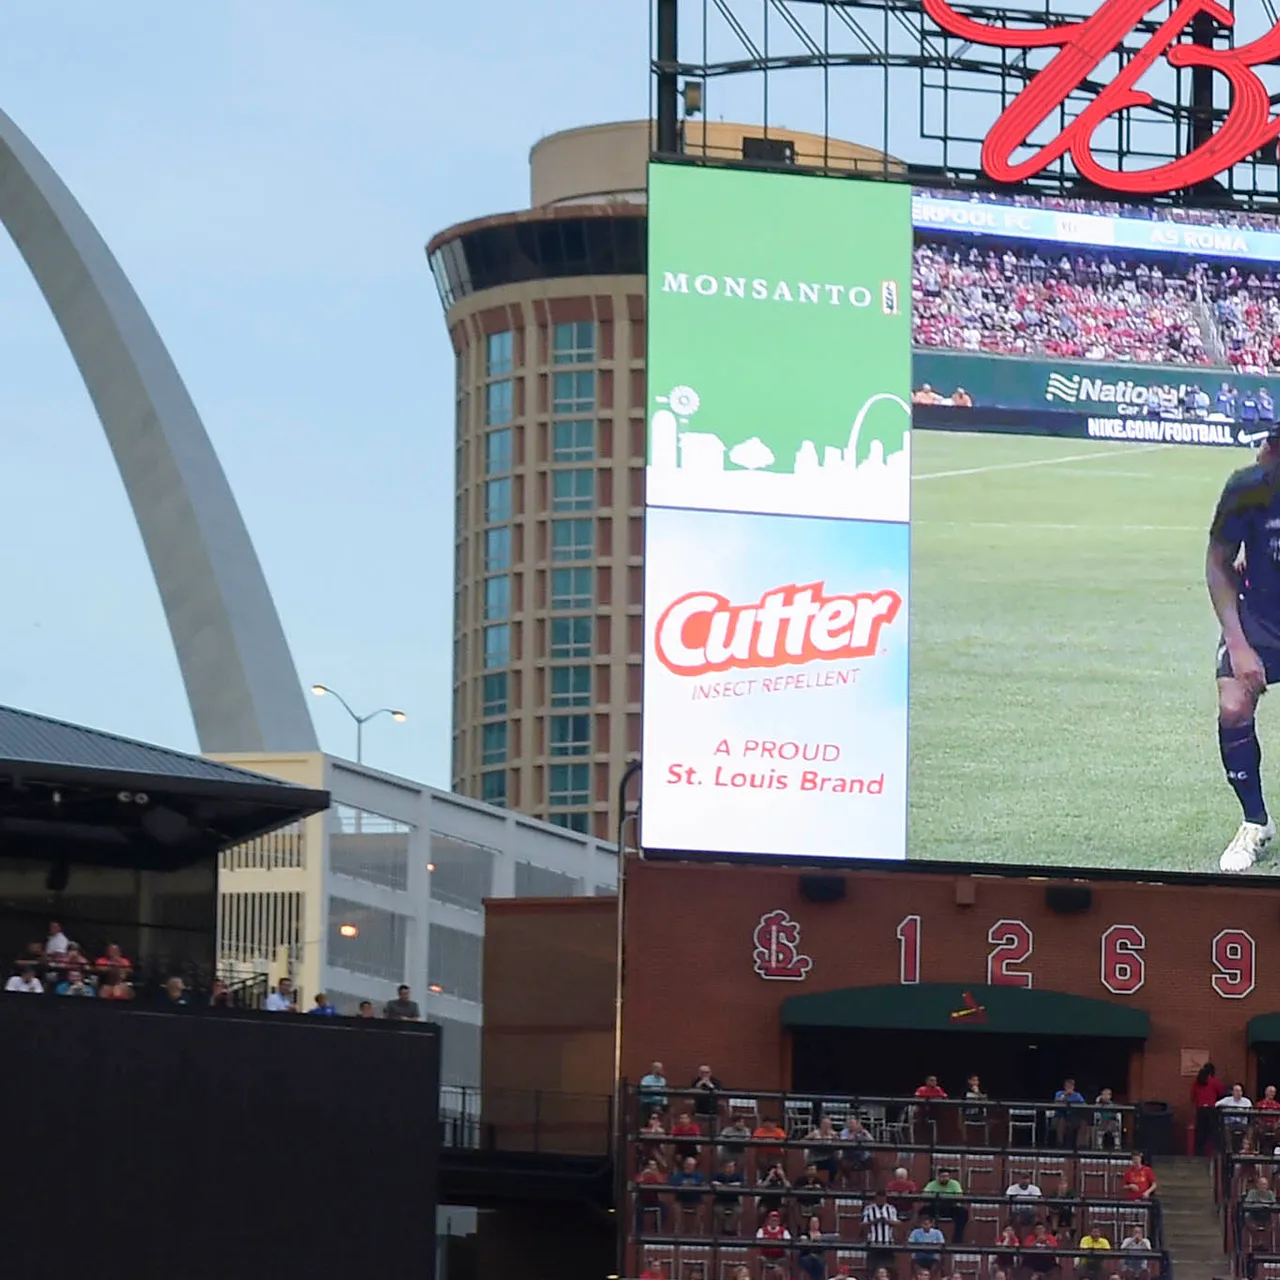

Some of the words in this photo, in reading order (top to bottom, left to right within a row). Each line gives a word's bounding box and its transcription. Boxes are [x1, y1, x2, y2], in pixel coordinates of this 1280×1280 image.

[1184, 231, 1249, 253] ROMA
[662, 271, 873, 307] MONSANTO
[1087, 416, 1235, 445] NIKE.COM/FOOTBALL
[659, 587, 894, 668] Cutter
[691, 679, 757, 701] INSECT
[762, 668, 861, 693] REPELLENT
[713, 738, 731, 756] A
[743, 739, 841, 762] PROUD
[666, 763, 702, 786] St.
[715, 766, 788, 790] Louis
[800, 770, 884, 795] Brand
[897, 915, 921, 985] 1
[986, 919, 1033, 989] 2
[1100, 924, 1146, 995] 6
[1211, 929, 1256, 999] 9
